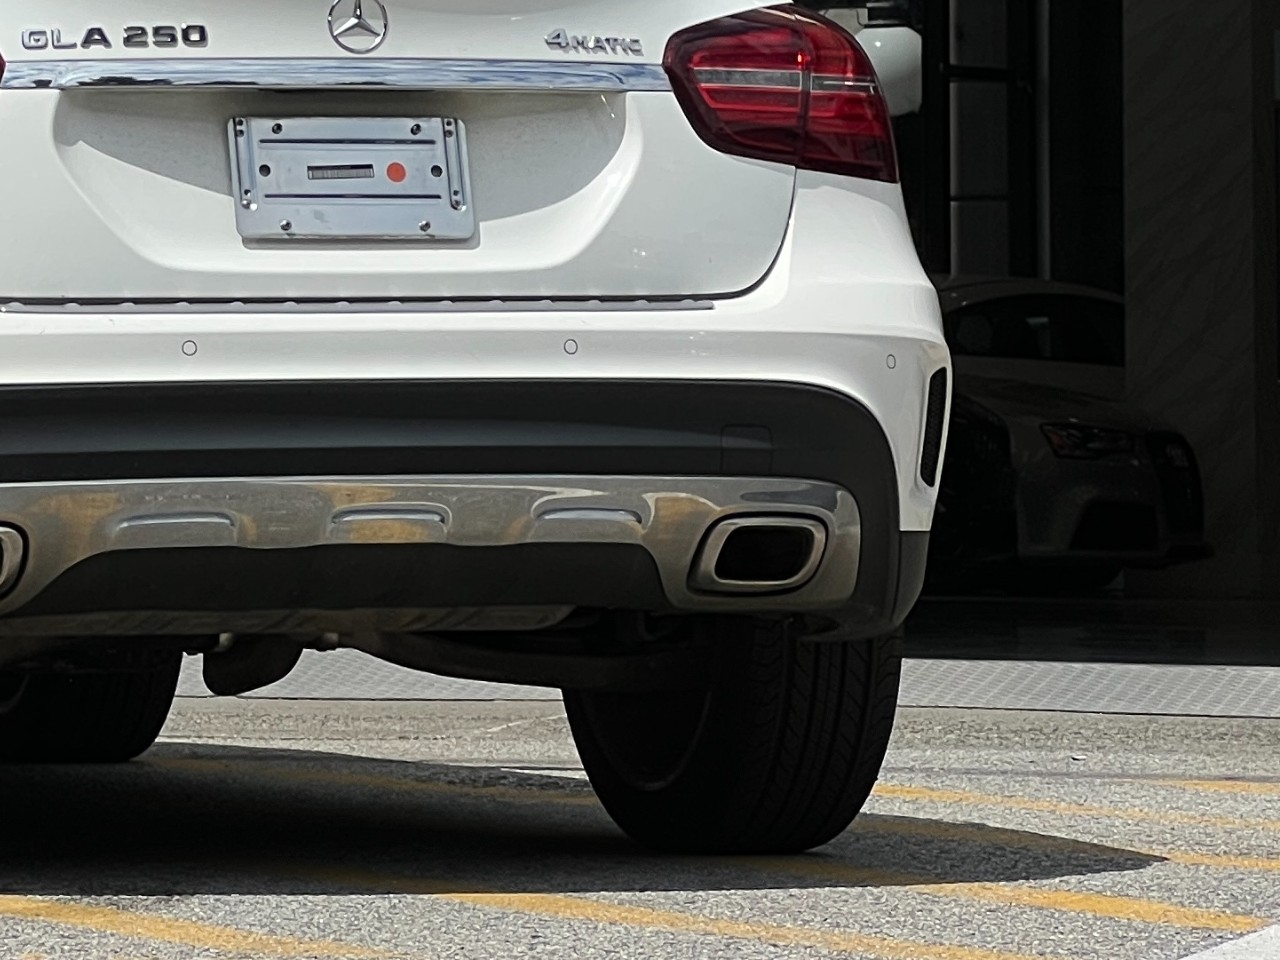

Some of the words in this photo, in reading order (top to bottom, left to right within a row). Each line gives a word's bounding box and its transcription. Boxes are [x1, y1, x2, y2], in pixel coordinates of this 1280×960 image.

[21, 26, 113, 50] GLA
[122, 24, 209, 48] 250
[544, 28, 644, 55] 4MATIC
